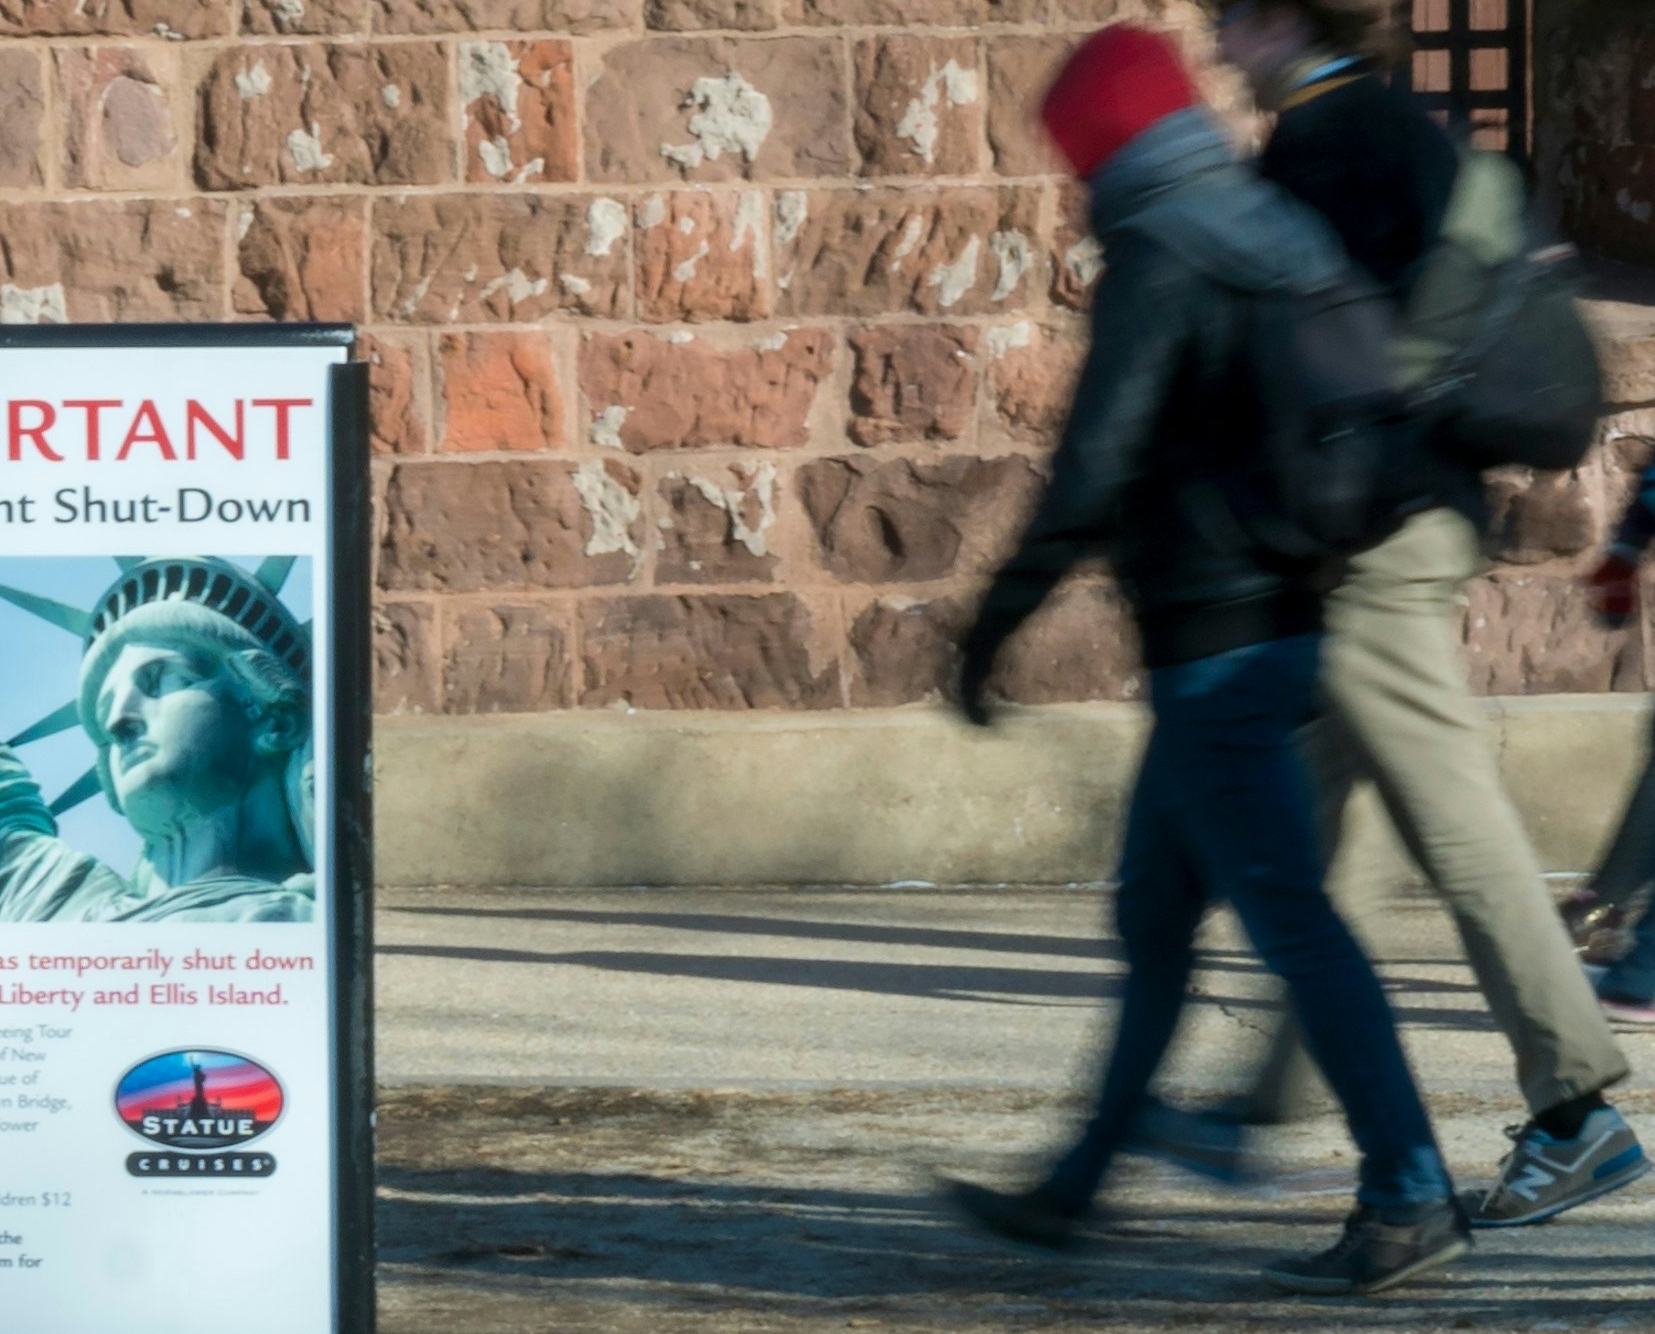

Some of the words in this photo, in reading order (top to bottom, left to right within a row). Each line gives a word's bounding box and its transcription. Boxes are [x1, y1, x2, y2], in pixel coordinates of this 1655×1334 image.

[53, 485, 313, 525] Shut-Down
[28, 948, 174, 977] temporarily
[182, 948, 236, 971] shut
[245, 948, 314, 971] down
[93, 983, 139, 1005] and
[150, 983, 198, 1005] Ellis
[208, 983, 288, 1005] Island.
[37, 1024, 73, 1039] Tour
[11, 1048, 47, 1062] New
[21, 1070, 41, 1085] of
[142, 1115, 255, 1136] STATUE
[41, 1192, 71, 1207] $12
[18, 1254, 43, 1268] for
